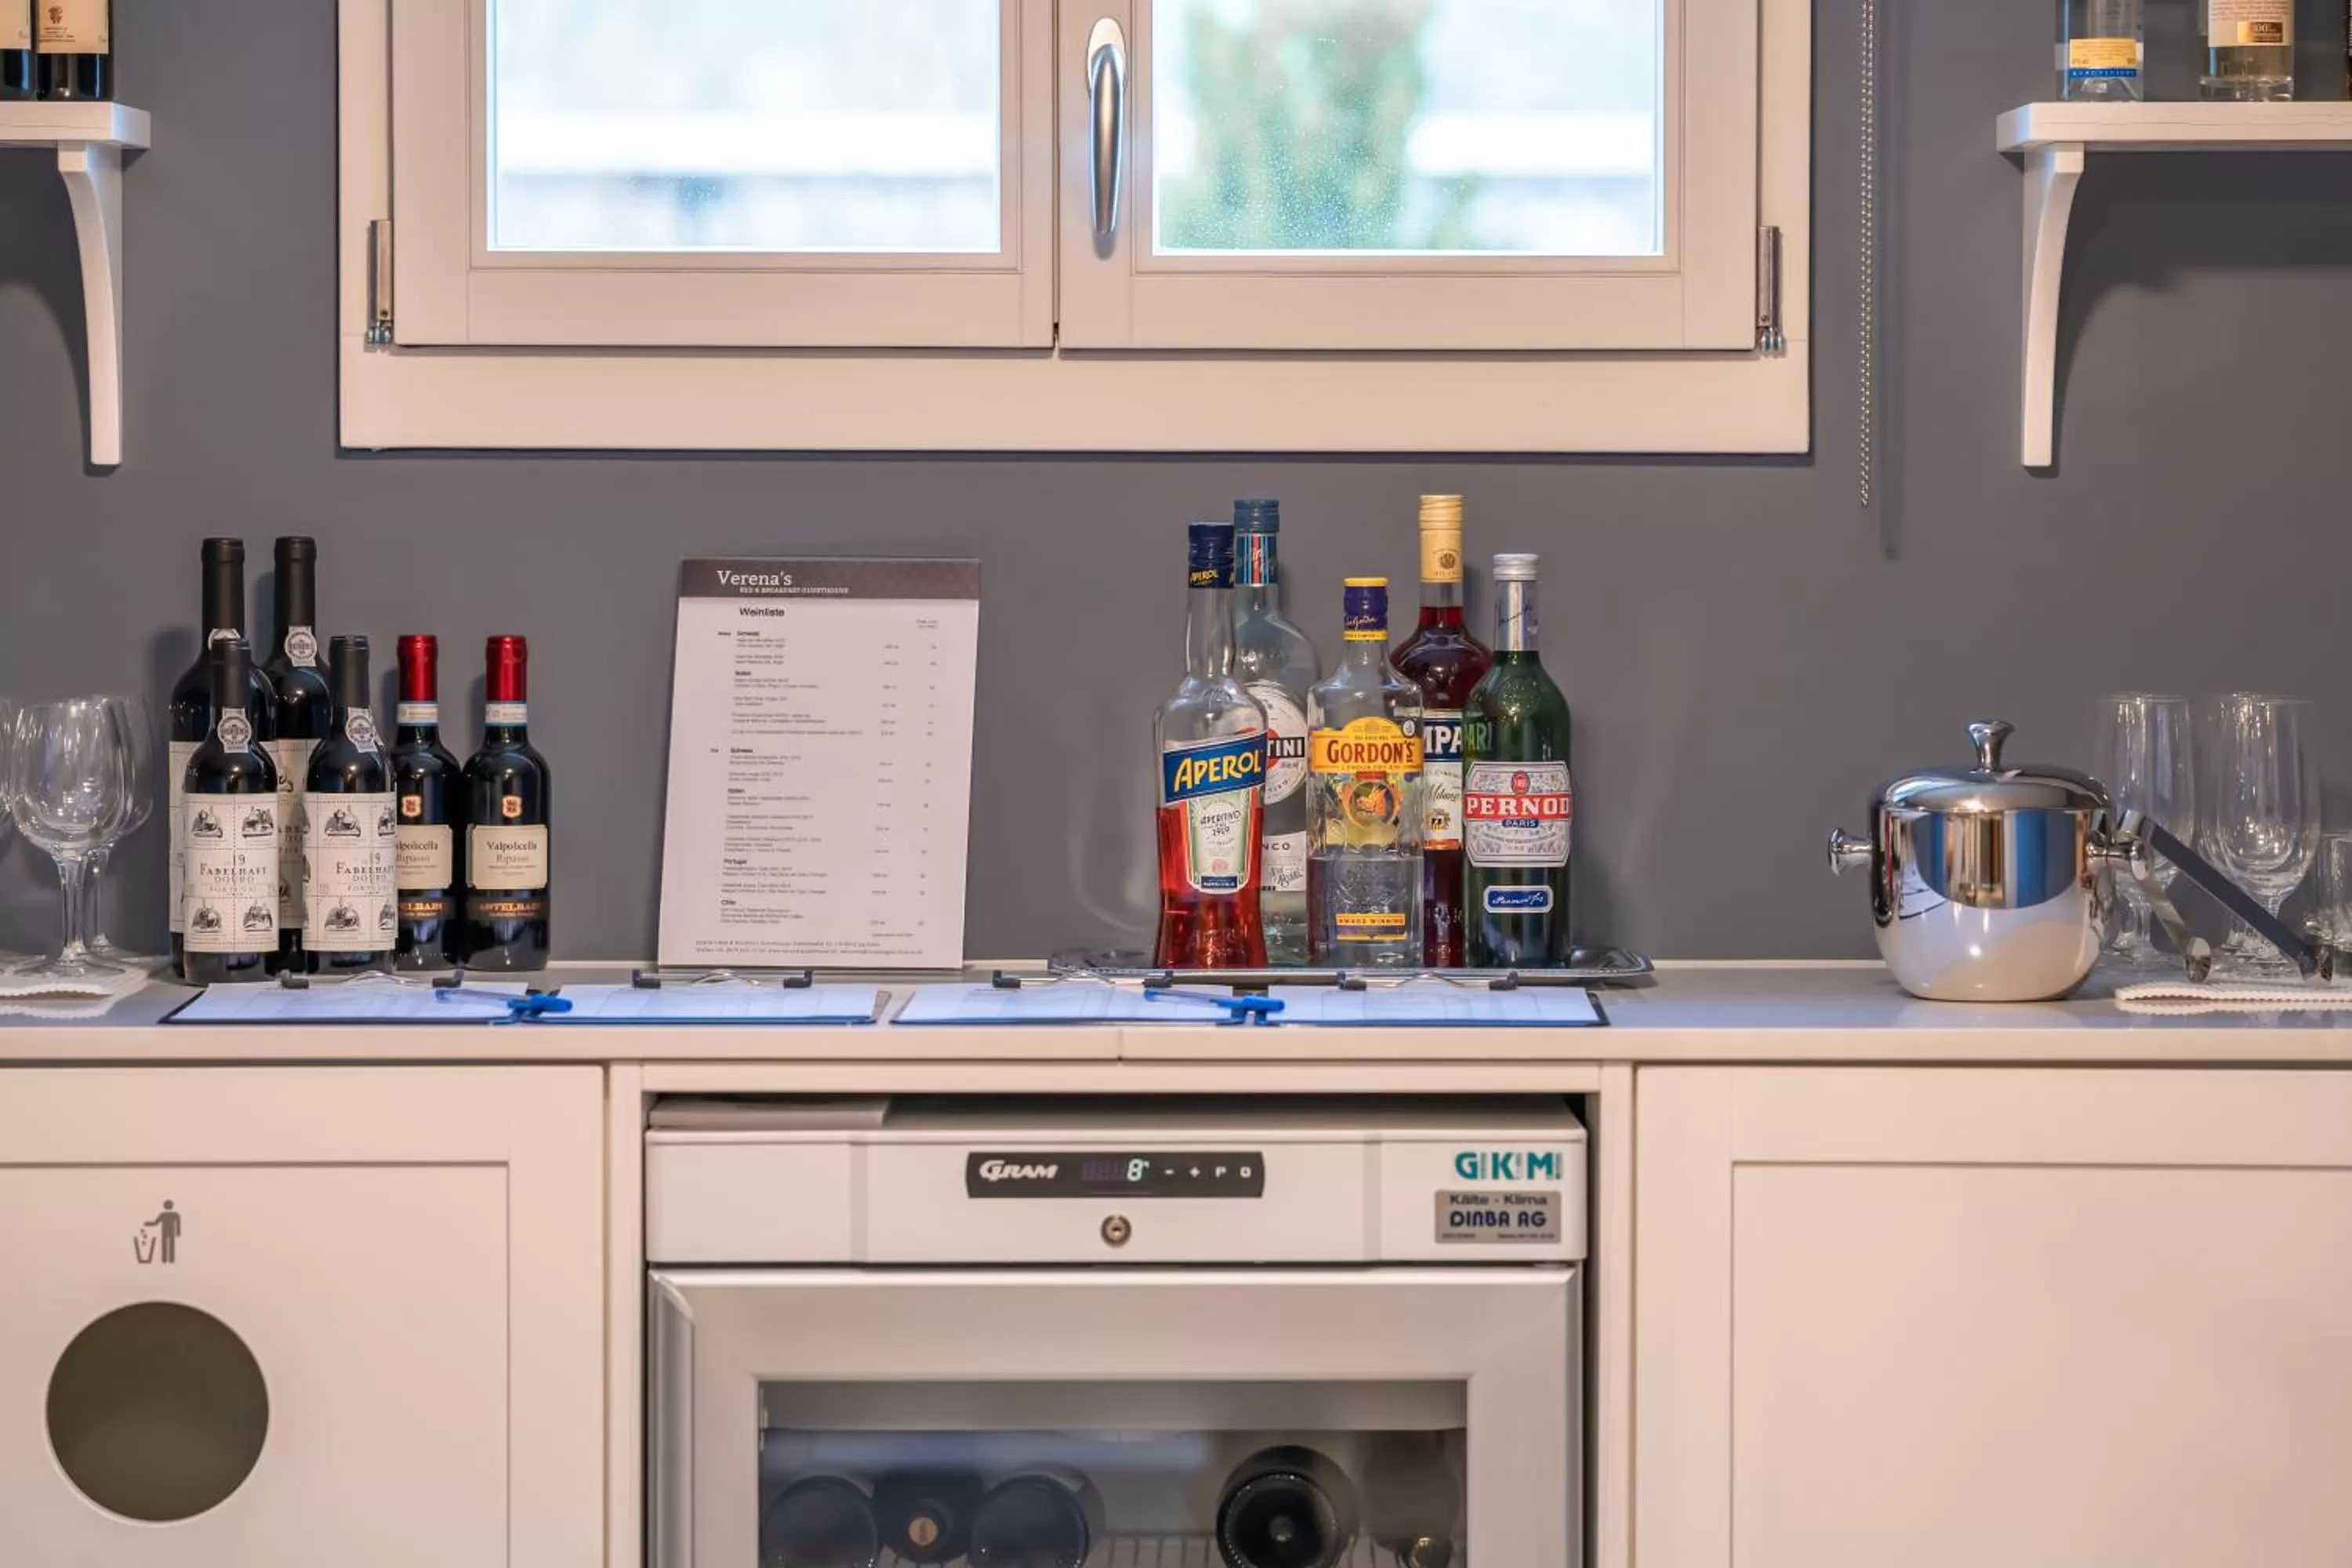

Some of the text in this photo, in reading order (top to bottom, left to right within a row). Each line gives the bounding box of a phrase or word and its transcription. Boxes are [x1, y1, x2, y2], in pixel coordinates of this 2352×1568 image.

[717, 570, 793, 586] Verena's
[739, 607, 785, 617] Weinliste
[1327, 739, 1414, 764] GORDON'S
[1174, 750, 1261, 793] APEROL
[1466, 797, 1569, 817] PERNOD
[979, 1160, 1058, 1181] GRAM
[1517, 1210, 1547, 1227] AG
